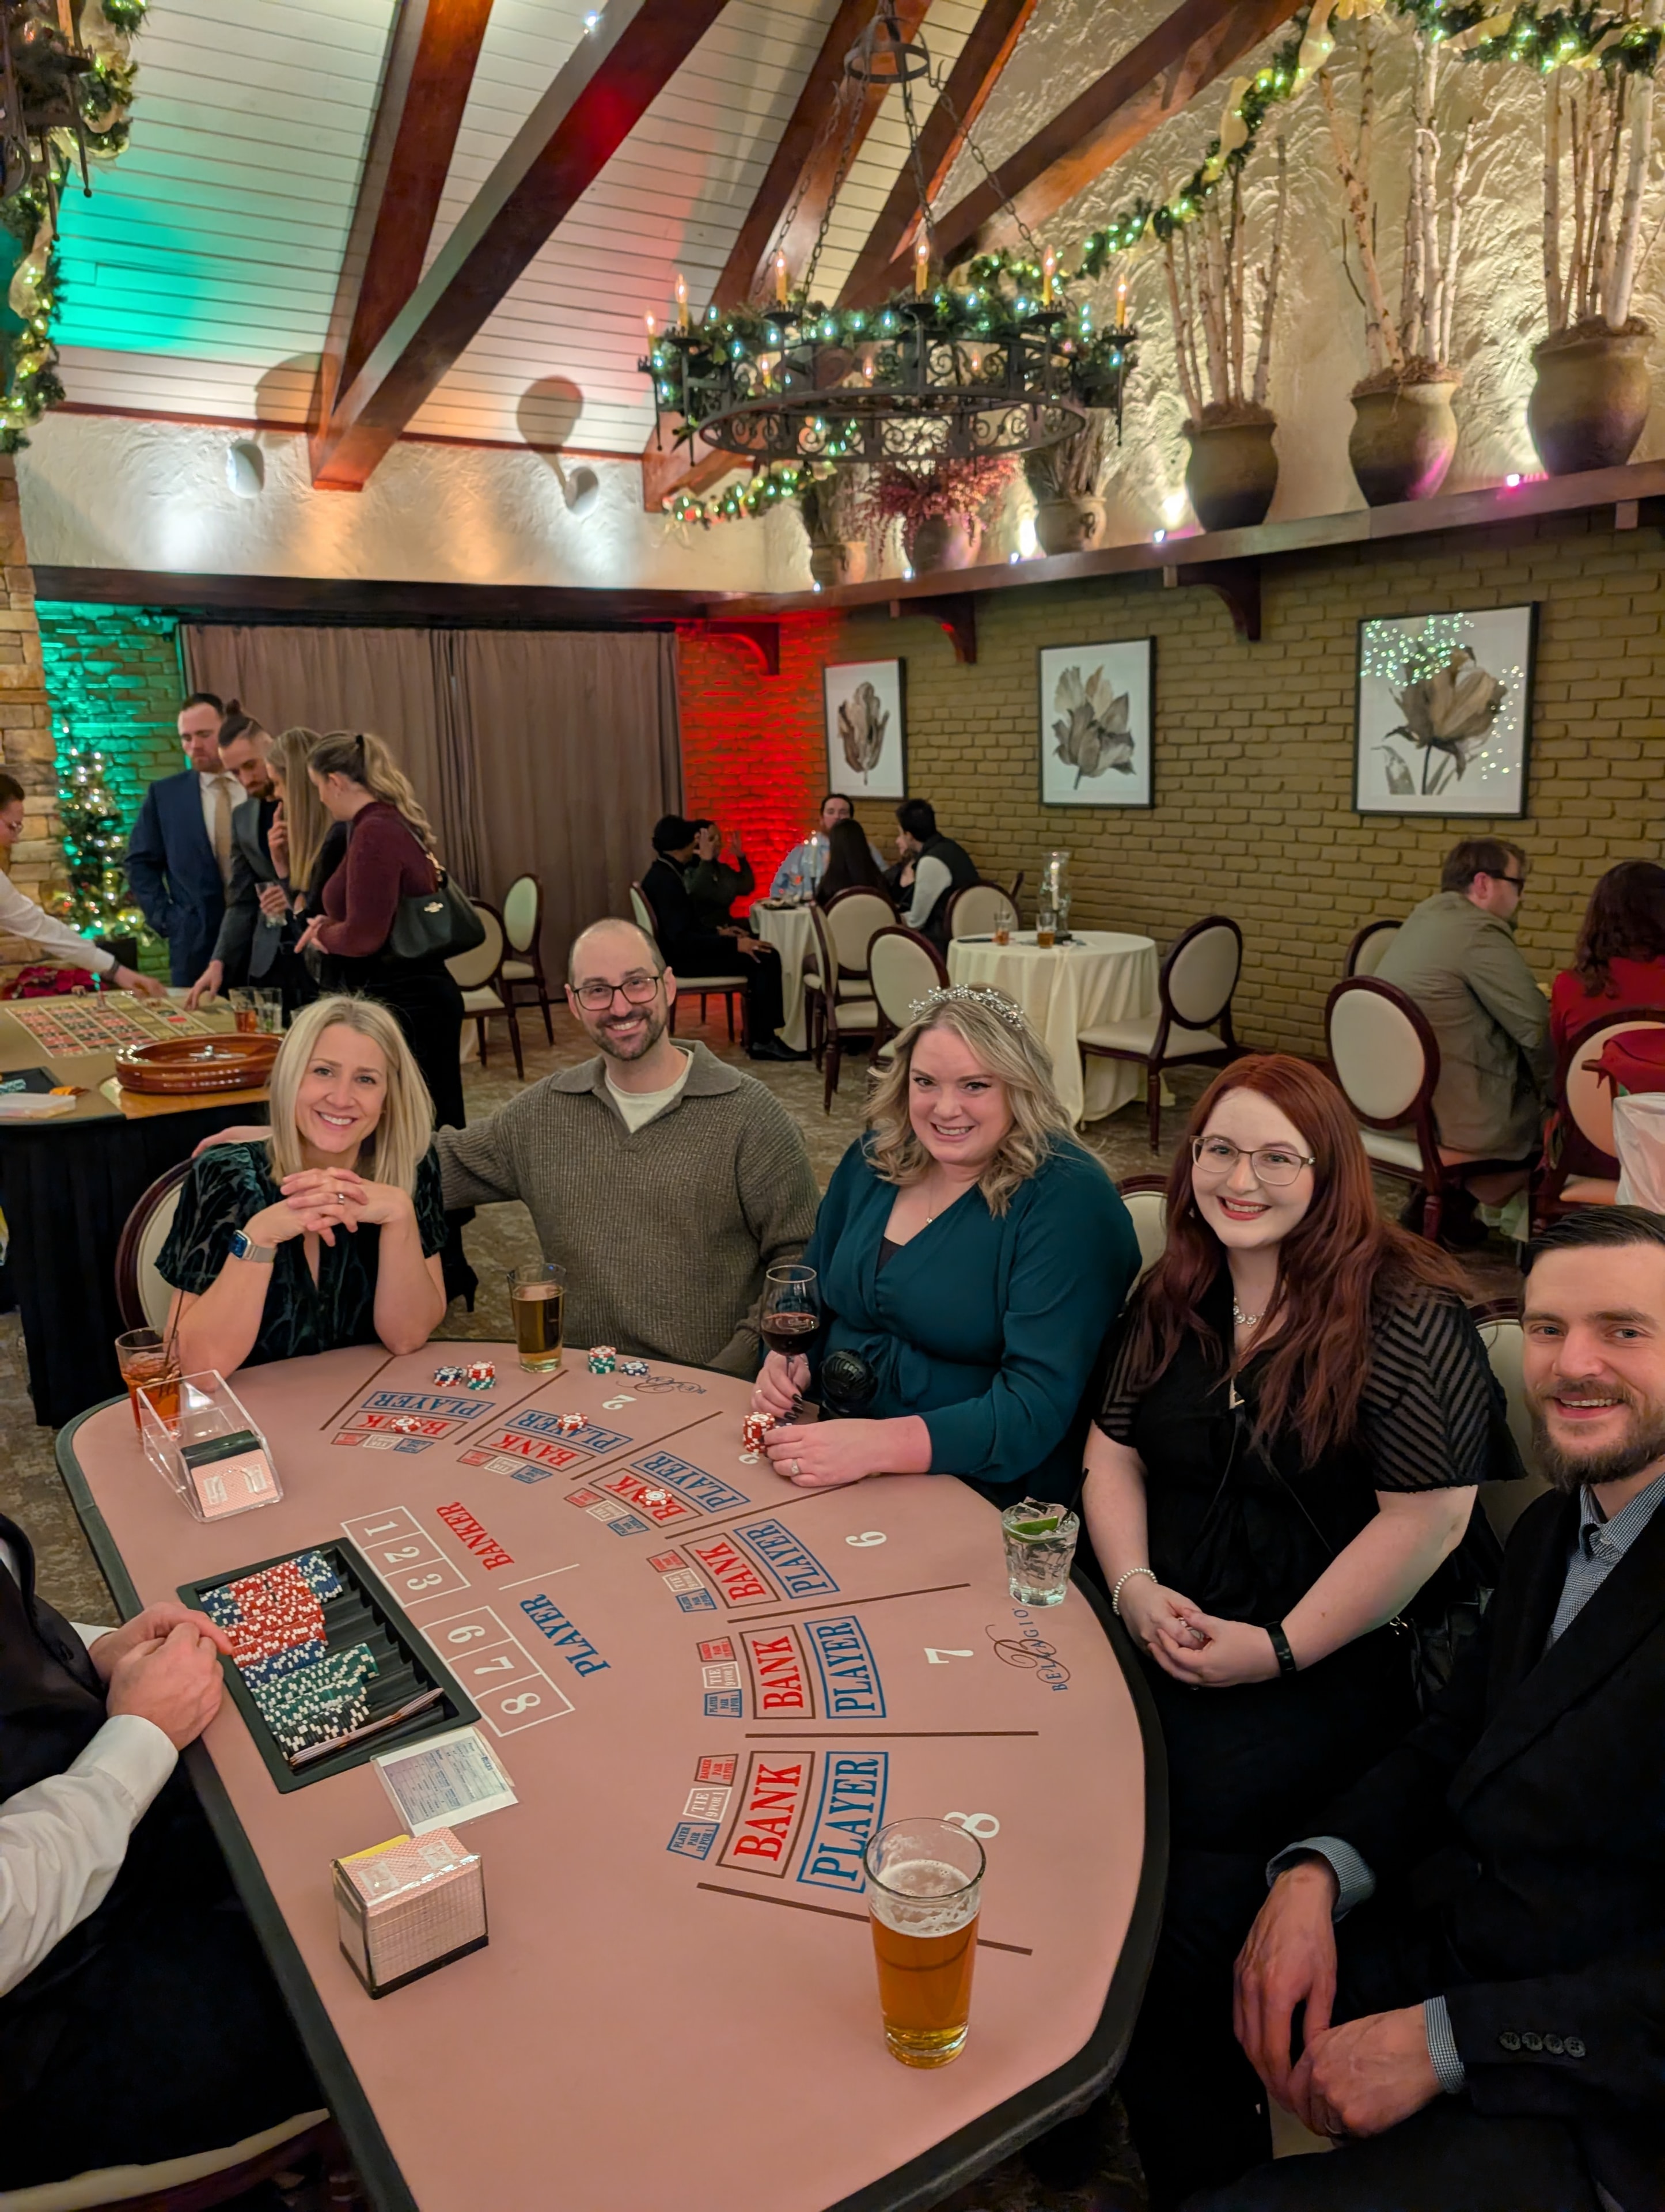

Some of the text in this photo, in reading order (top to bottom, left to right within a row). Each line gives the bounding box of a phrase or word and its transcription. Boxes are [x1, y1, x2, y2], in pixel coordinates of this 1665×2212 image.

[374, 1394, 485, 1416] PLAYER
[602, 1394, 637, 1410] 2
[492, 1434, 578, 1467] BANK
[643, 1455, 739, 1508] PLAYER
[437, 1501, 515, 1571] BANKER
[845, 1531, 887, 1547] 6
[364, 1521, 442, 1590] 1 2 3
[746, 1525, 828, 1593] PLAYER
[695, 1542, 766, 1600] BANK
[519, 1593, 611, 1677] PLAYER
[447, 1625, 541, 1714] 6 7 8
[817, 1622, 876, 1713] PLAYER
[924, 1647, 974, 1664] 7
[709, 1669, 722, 1685] TIE
[752, 1635, 804, 1710] BANK
[712, 1763, 723, 1775] PAIR
[691, 1793, 710, 1812] TIE
[708, 1797, 722, 1811] FOR
[733, 1764, 802, 1861] BANK
[810, 1758, 879, 1882] PLAYER
[943, 1811, 1000, 1838] 8
[673, 1827, 691, 1848] PLAYER
[688, 1832, 700, 1846] PAIR
[699, 1832, 712, 1846] FOR
